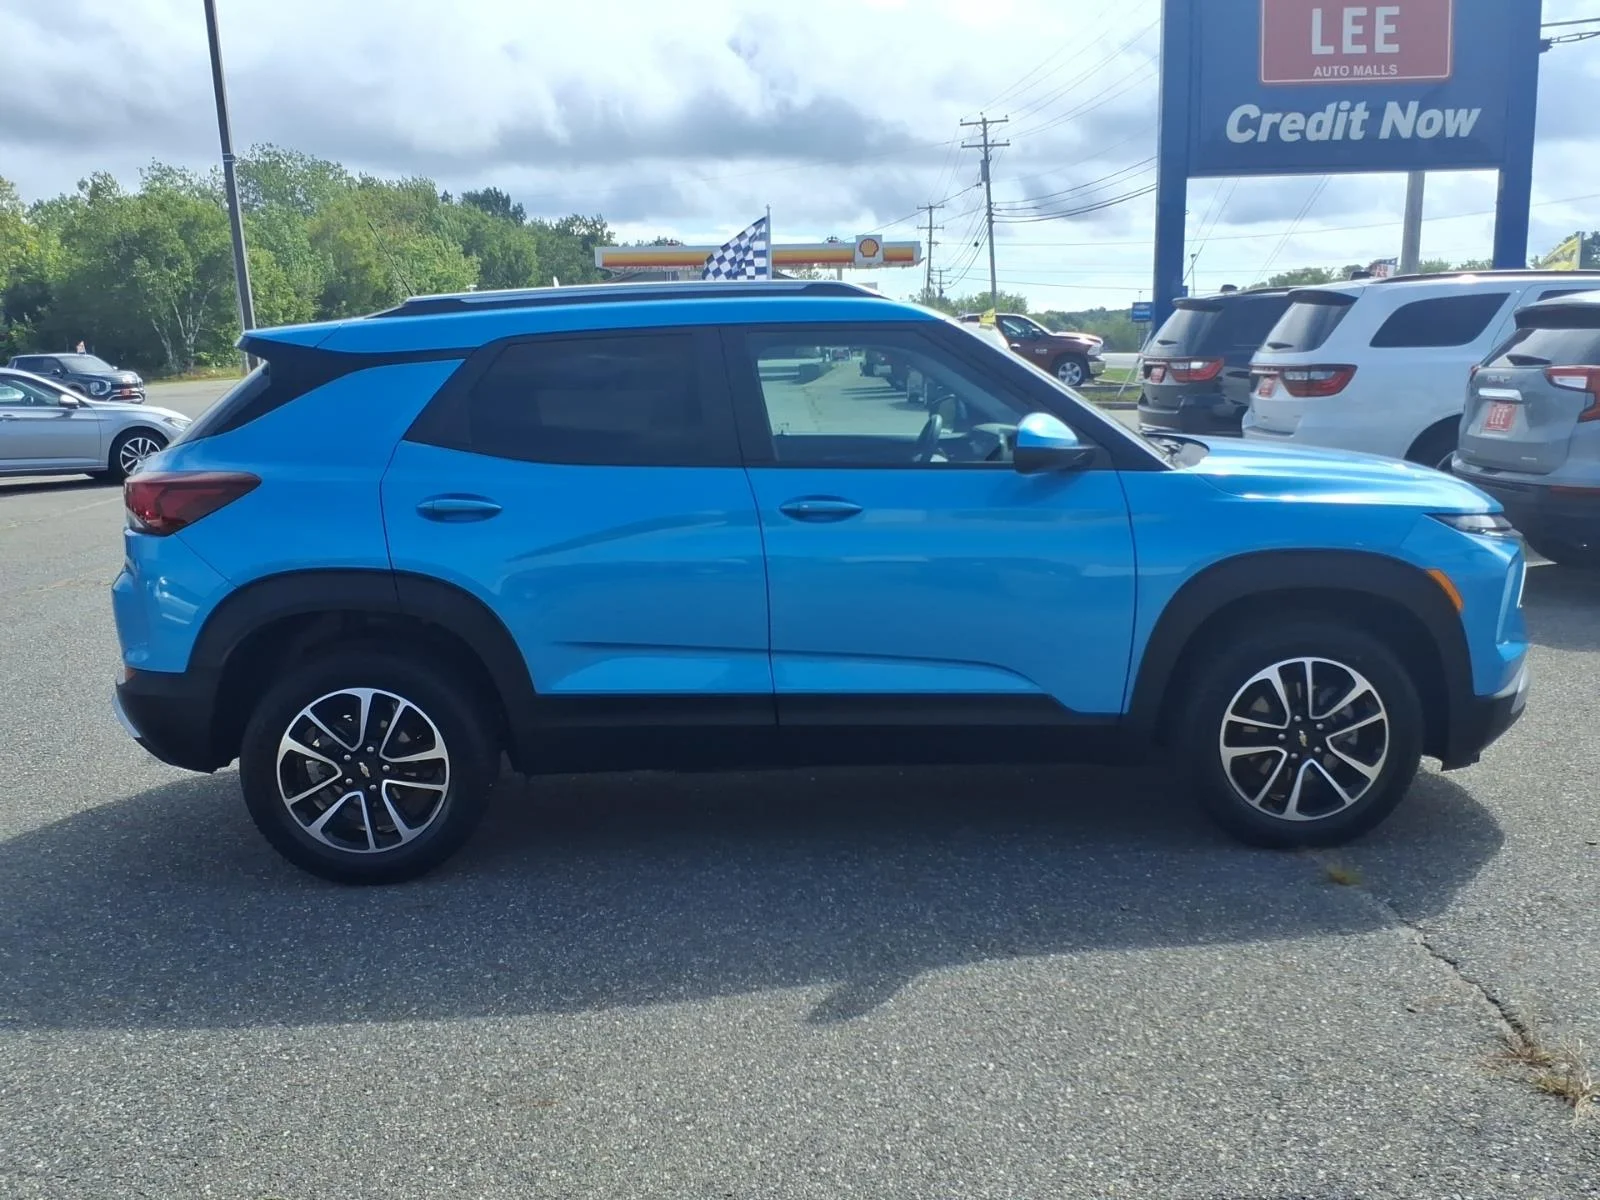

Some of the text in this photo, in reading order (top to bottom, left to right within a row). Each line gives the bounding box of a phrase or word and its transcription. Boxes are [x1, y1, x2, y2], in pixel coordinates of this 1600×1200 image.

[1311, 6, 1399, 55] LEE
[1313, 64, 1398, 77] AUTO MALLS
[1226, 101, 1481, 142] Credit Now
